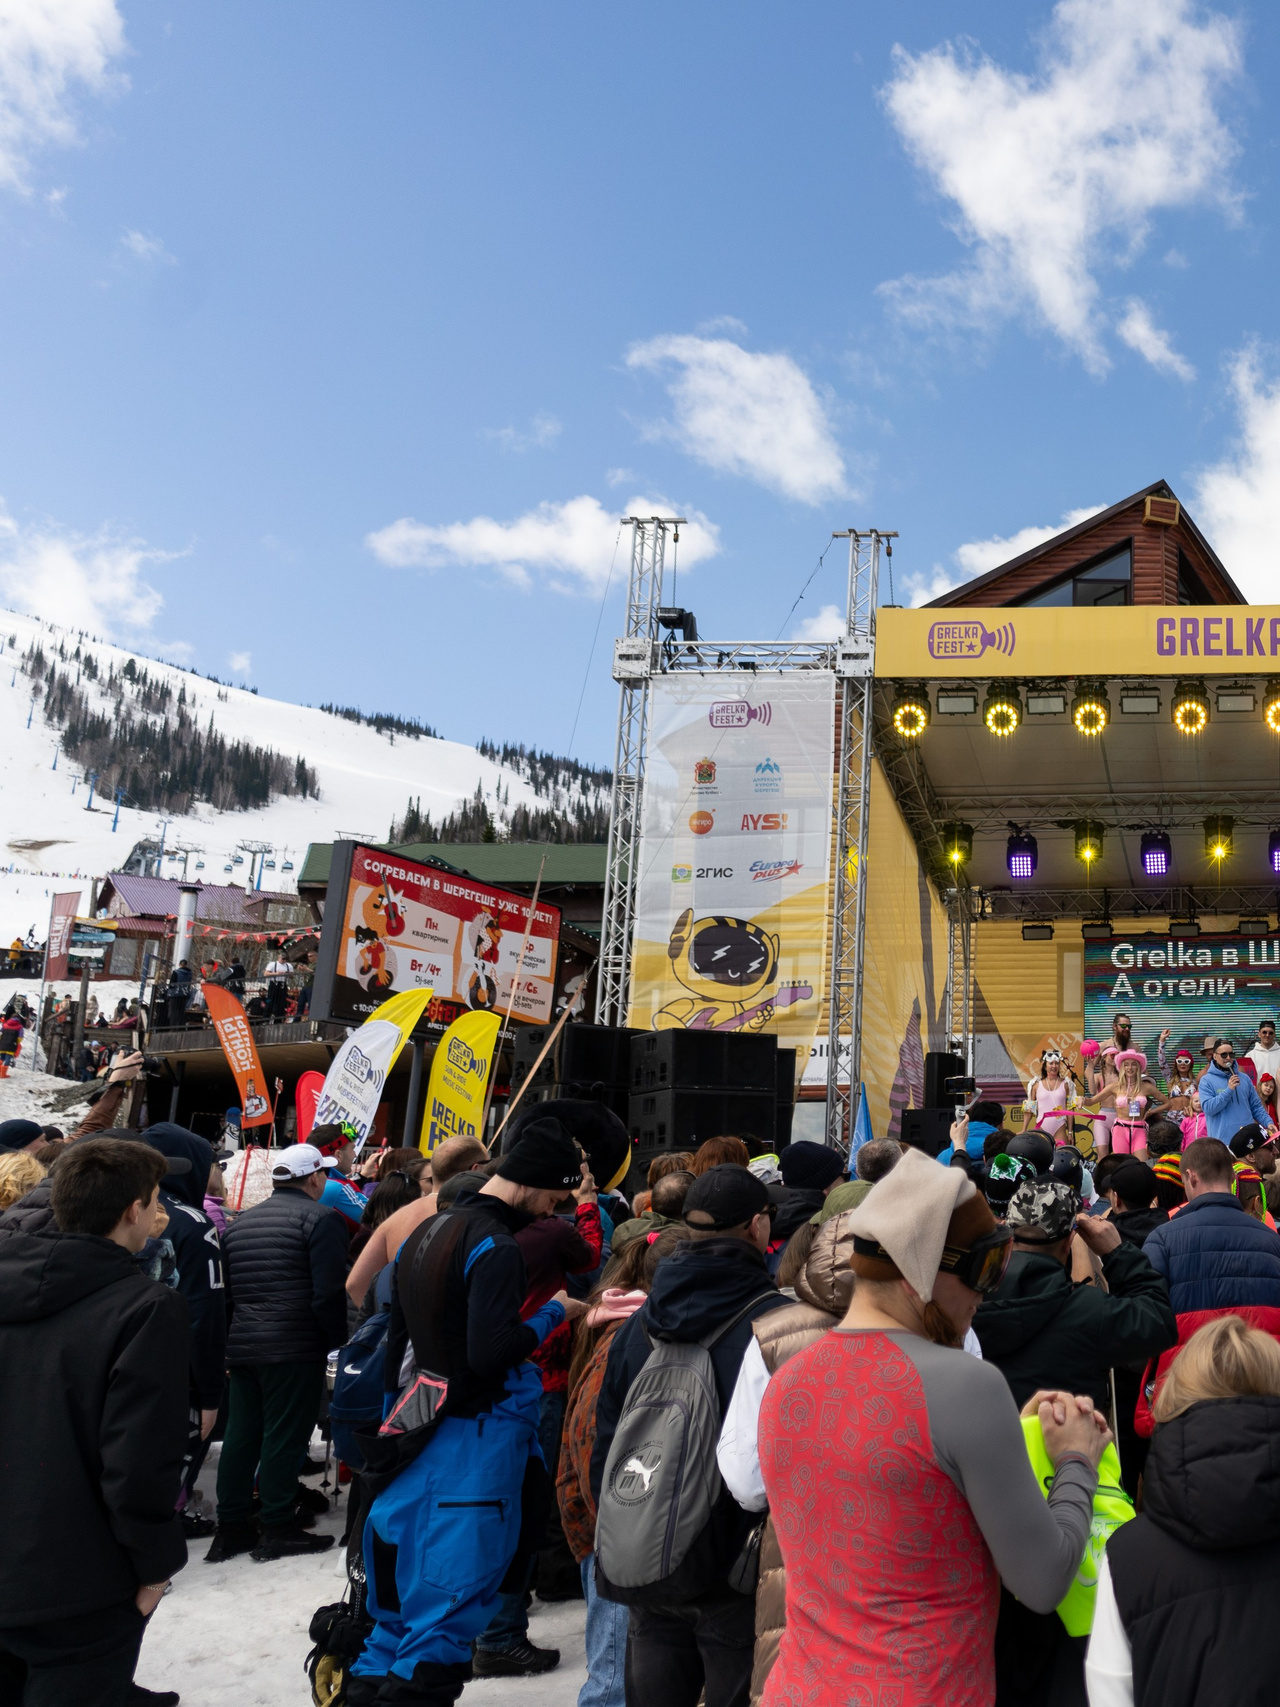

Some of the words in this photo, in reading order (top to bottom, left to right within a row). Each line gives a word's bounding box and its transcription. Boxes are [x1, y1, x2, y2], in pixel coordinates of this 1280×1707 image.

[936, 626, 979, 640] GRELKA
[936, 640, 965, 654] FEST
[715, 702, 746, 714] GRELKA
[715, 714, 736, 725] FEST
[740, 813, 789, 831] AYS!
[696, 867, 734, 879] 2ГИС
[363, 859, 431, 889] СОГРЕВАЕМ
[433, 881, 441, 890] В
[443, 883, 497, 907] ШЕРЕГЕШЕ
[499, 900, 520, 915] УЖЕ
[425, 917, 440, 931] Пн.
[411, 929, 450, 945] квартирник
[1110, 942, 1212, 969] Grelka
[1221, 948, 1239, 966] в
[1110, 972, 1135, 998] А
[1143, 977, 1236, 997] отели
[563, 1174, 582, 1184] GIV
